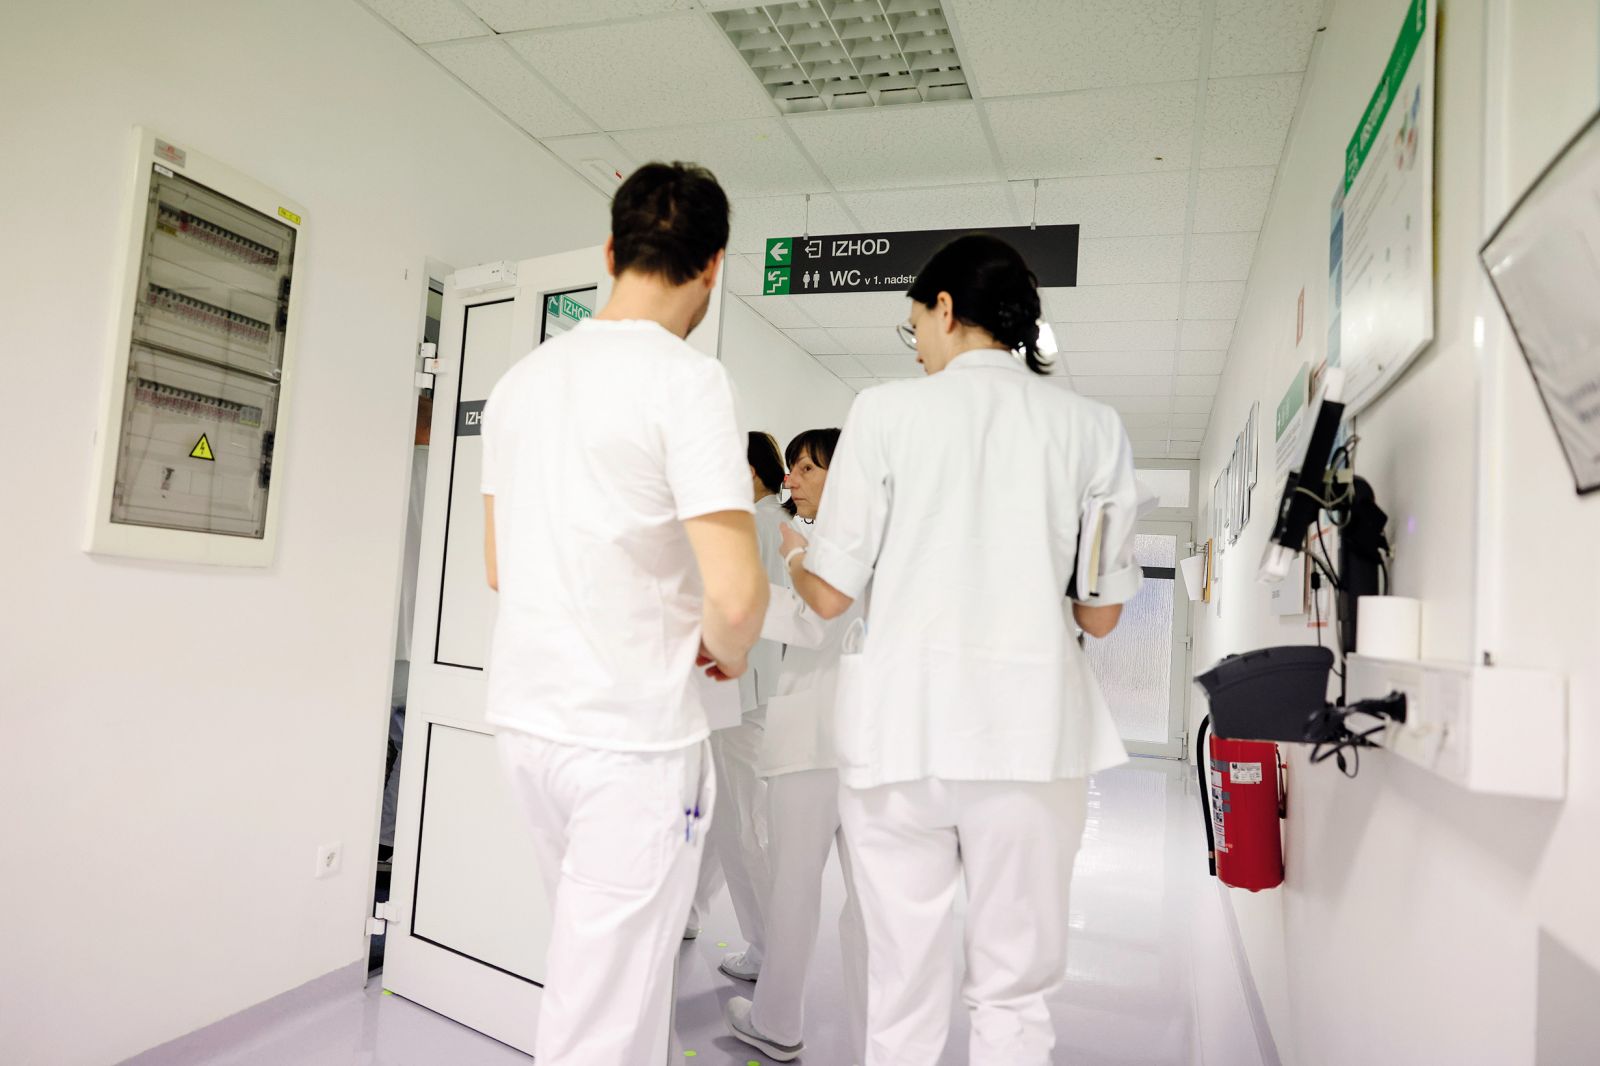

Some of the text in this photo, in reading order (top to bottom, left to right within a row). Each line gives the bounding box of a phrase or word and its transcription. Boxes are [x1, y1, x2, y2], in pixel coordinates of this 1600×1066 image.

[832, 238, 890, 257] IZHOD
[829, 269, 861, 287] WC
[864, 277, 871, 285] v
[873, 275, 881, 285] 1.
